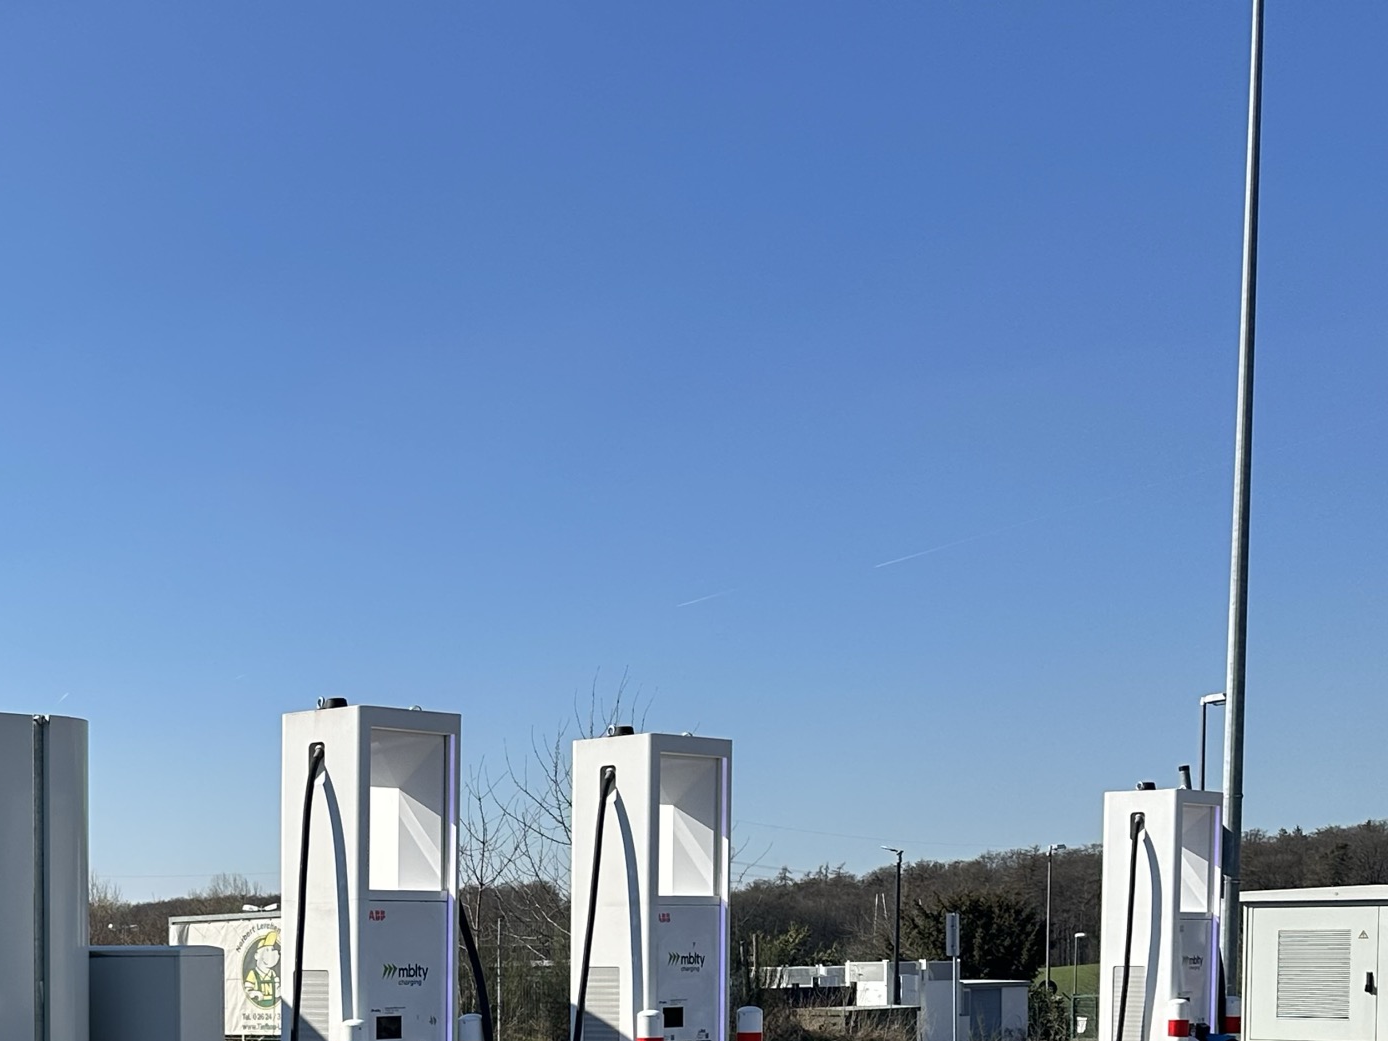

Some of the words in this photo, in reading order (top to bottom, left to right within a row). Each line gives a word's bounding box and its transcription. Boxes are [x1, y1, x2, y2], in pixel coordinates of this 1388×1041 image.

[368, 910, 386, 921] ABB
[680, 952, 705, 968] mblty
[398, 963, 429, 981] mblty
[398, 979, 422, 987] charging
